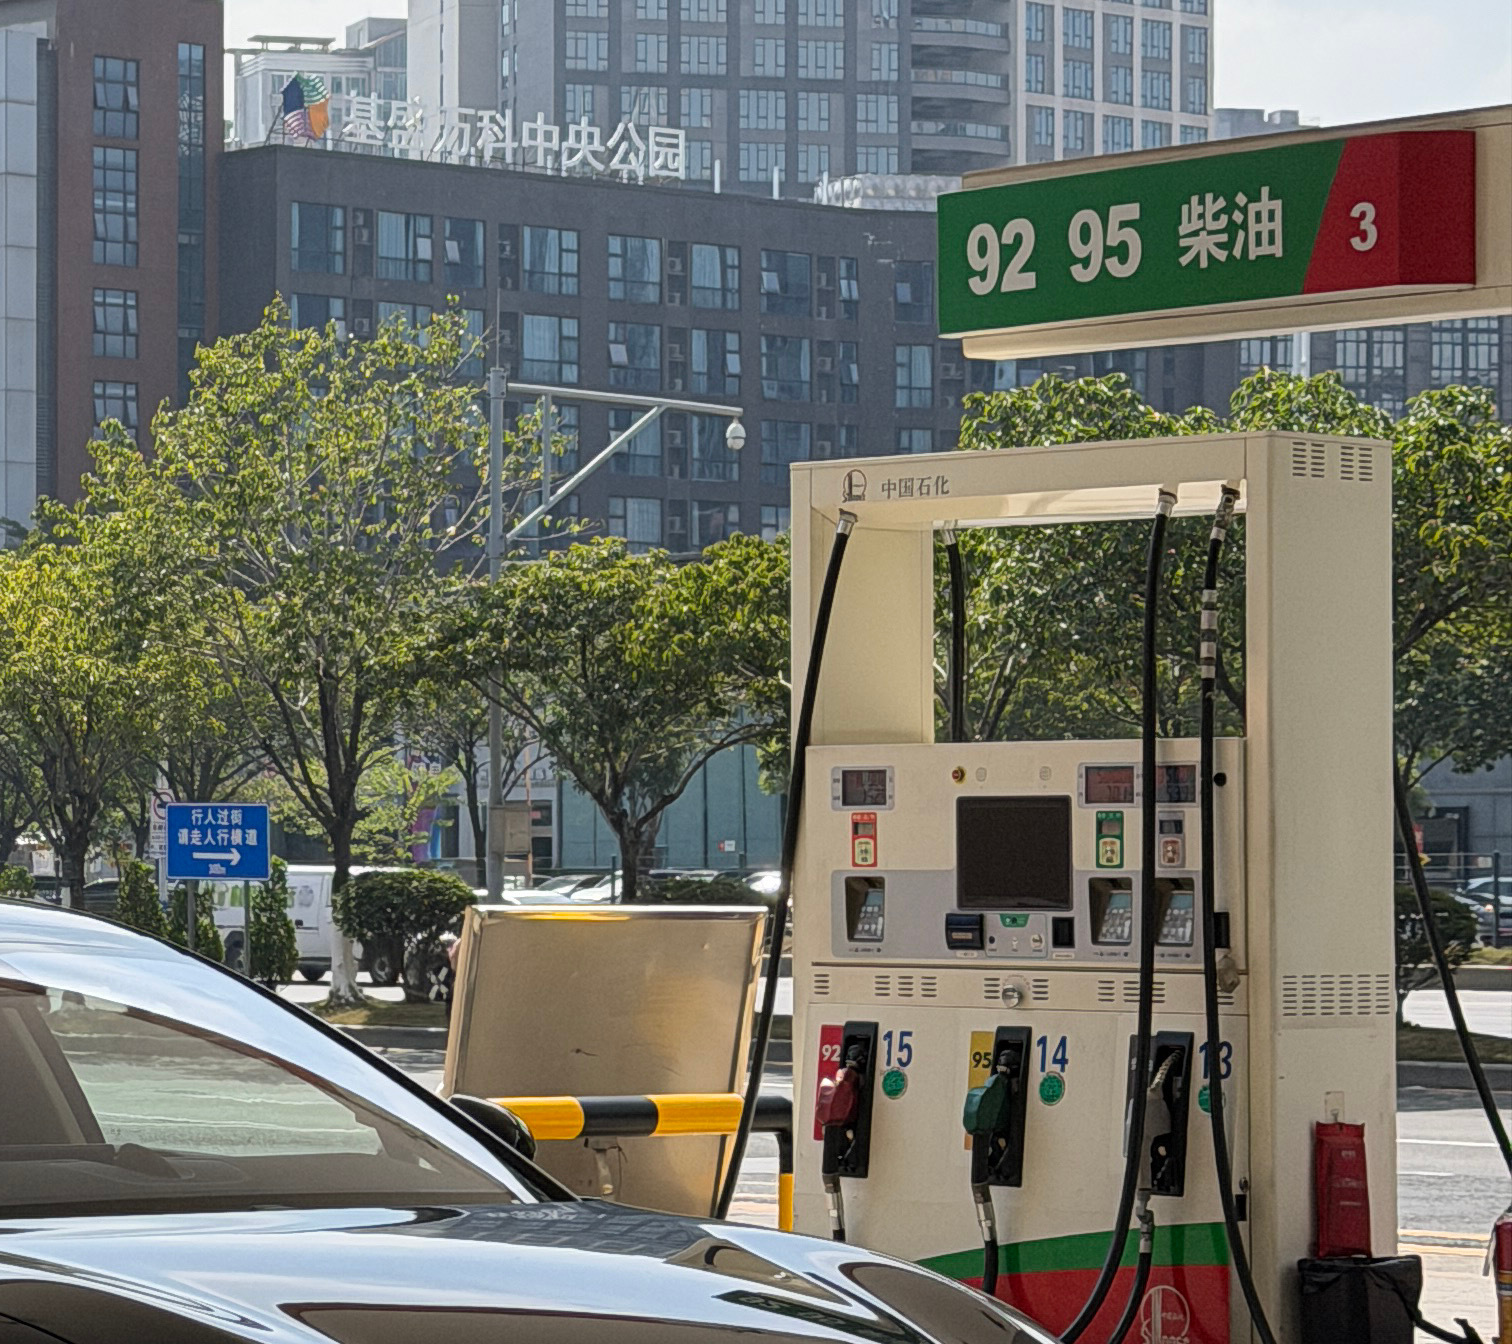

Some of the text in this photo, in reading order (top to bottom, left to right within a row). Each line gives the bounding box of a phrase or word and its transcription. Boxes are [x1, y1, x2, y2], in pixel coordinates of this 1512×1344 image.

[966, 186, 1284, 296] 92 95 柴油
[1349, 202, 1378, 252] 3
[881, 475, 950, 499] 中国石化
[191, 808, 243, 825] 行人过街
[822, 1044, 841, 1062] 92
[883, 1030, 913, 1067] 15
[972, 1051, 992, 1068] 95
[1036, 1035, 1068, 1073] 14
